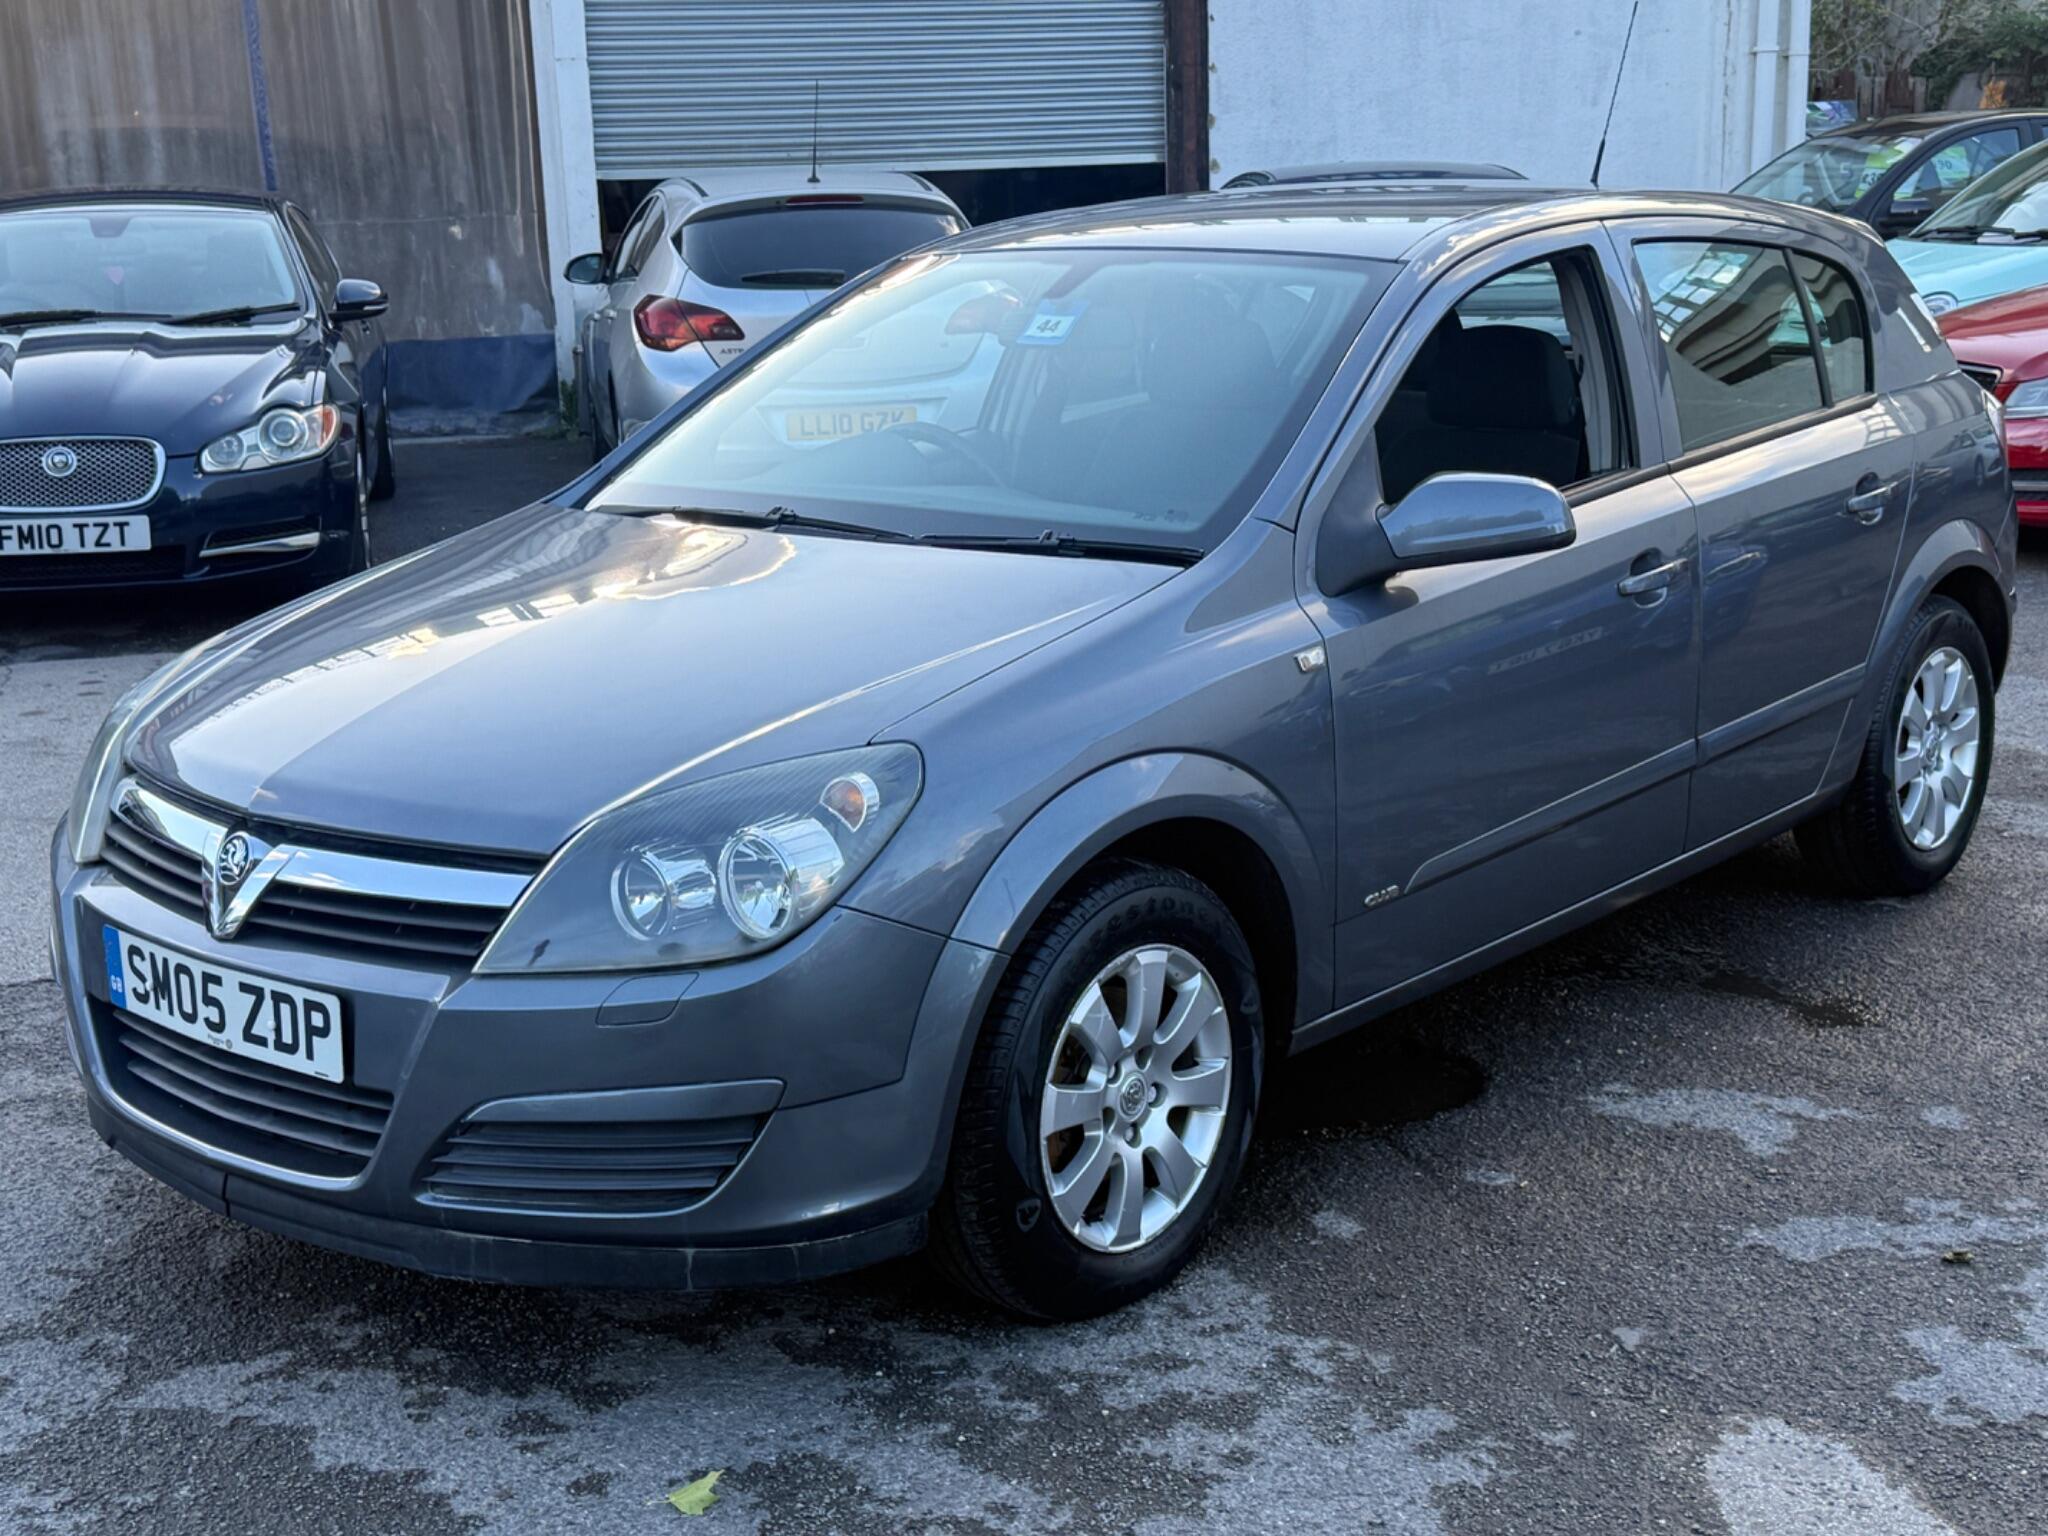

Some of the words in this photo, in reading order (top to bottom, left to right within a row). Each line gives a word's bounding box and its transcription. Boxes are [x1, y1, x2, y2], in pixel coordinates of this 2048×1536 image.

[1036, 319, 1061, 333] 44
[800, 412, 853, 436] LL10
[0, 523, 63, 550] FM10
[72, 521, 130, 548] TZT
[127, 943, 226, 1035] SM05
[238, 980, 331, 1062] ZDP
